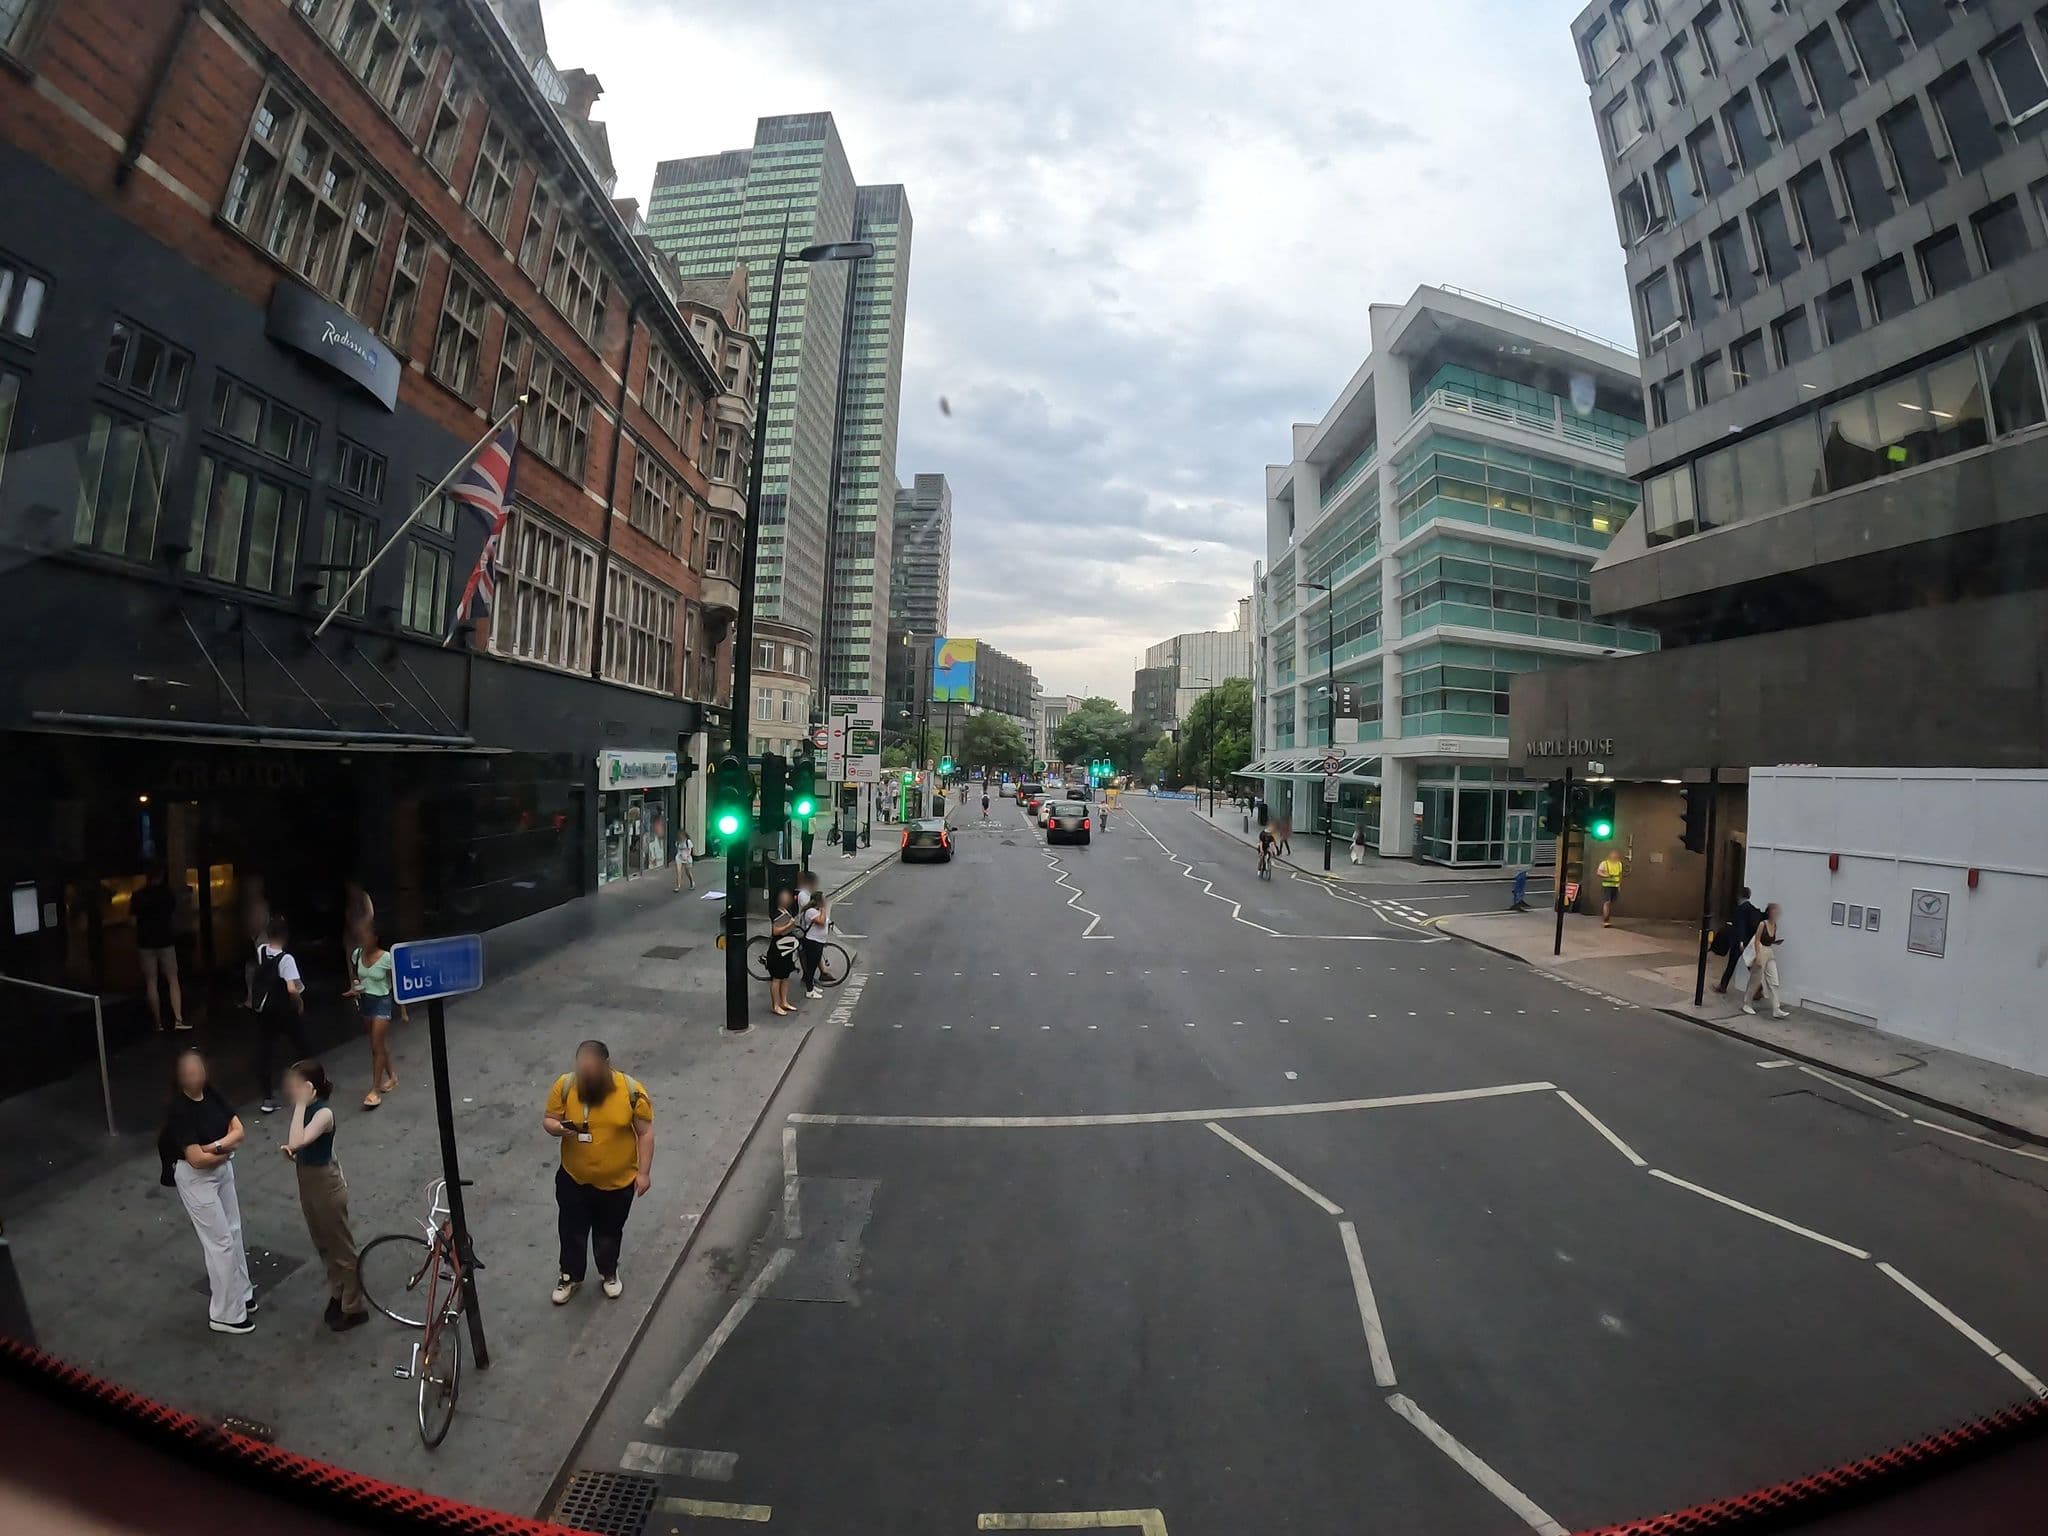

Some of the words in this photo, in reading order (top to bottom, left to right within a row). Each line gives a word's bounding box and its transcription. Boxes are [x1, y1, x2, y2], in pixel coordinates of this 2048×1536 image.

[1526, 740, 1565, 757] MAPLE
[1567, 738, 1615, 757] HOUSE
[403, 975, 433, 991] bus
